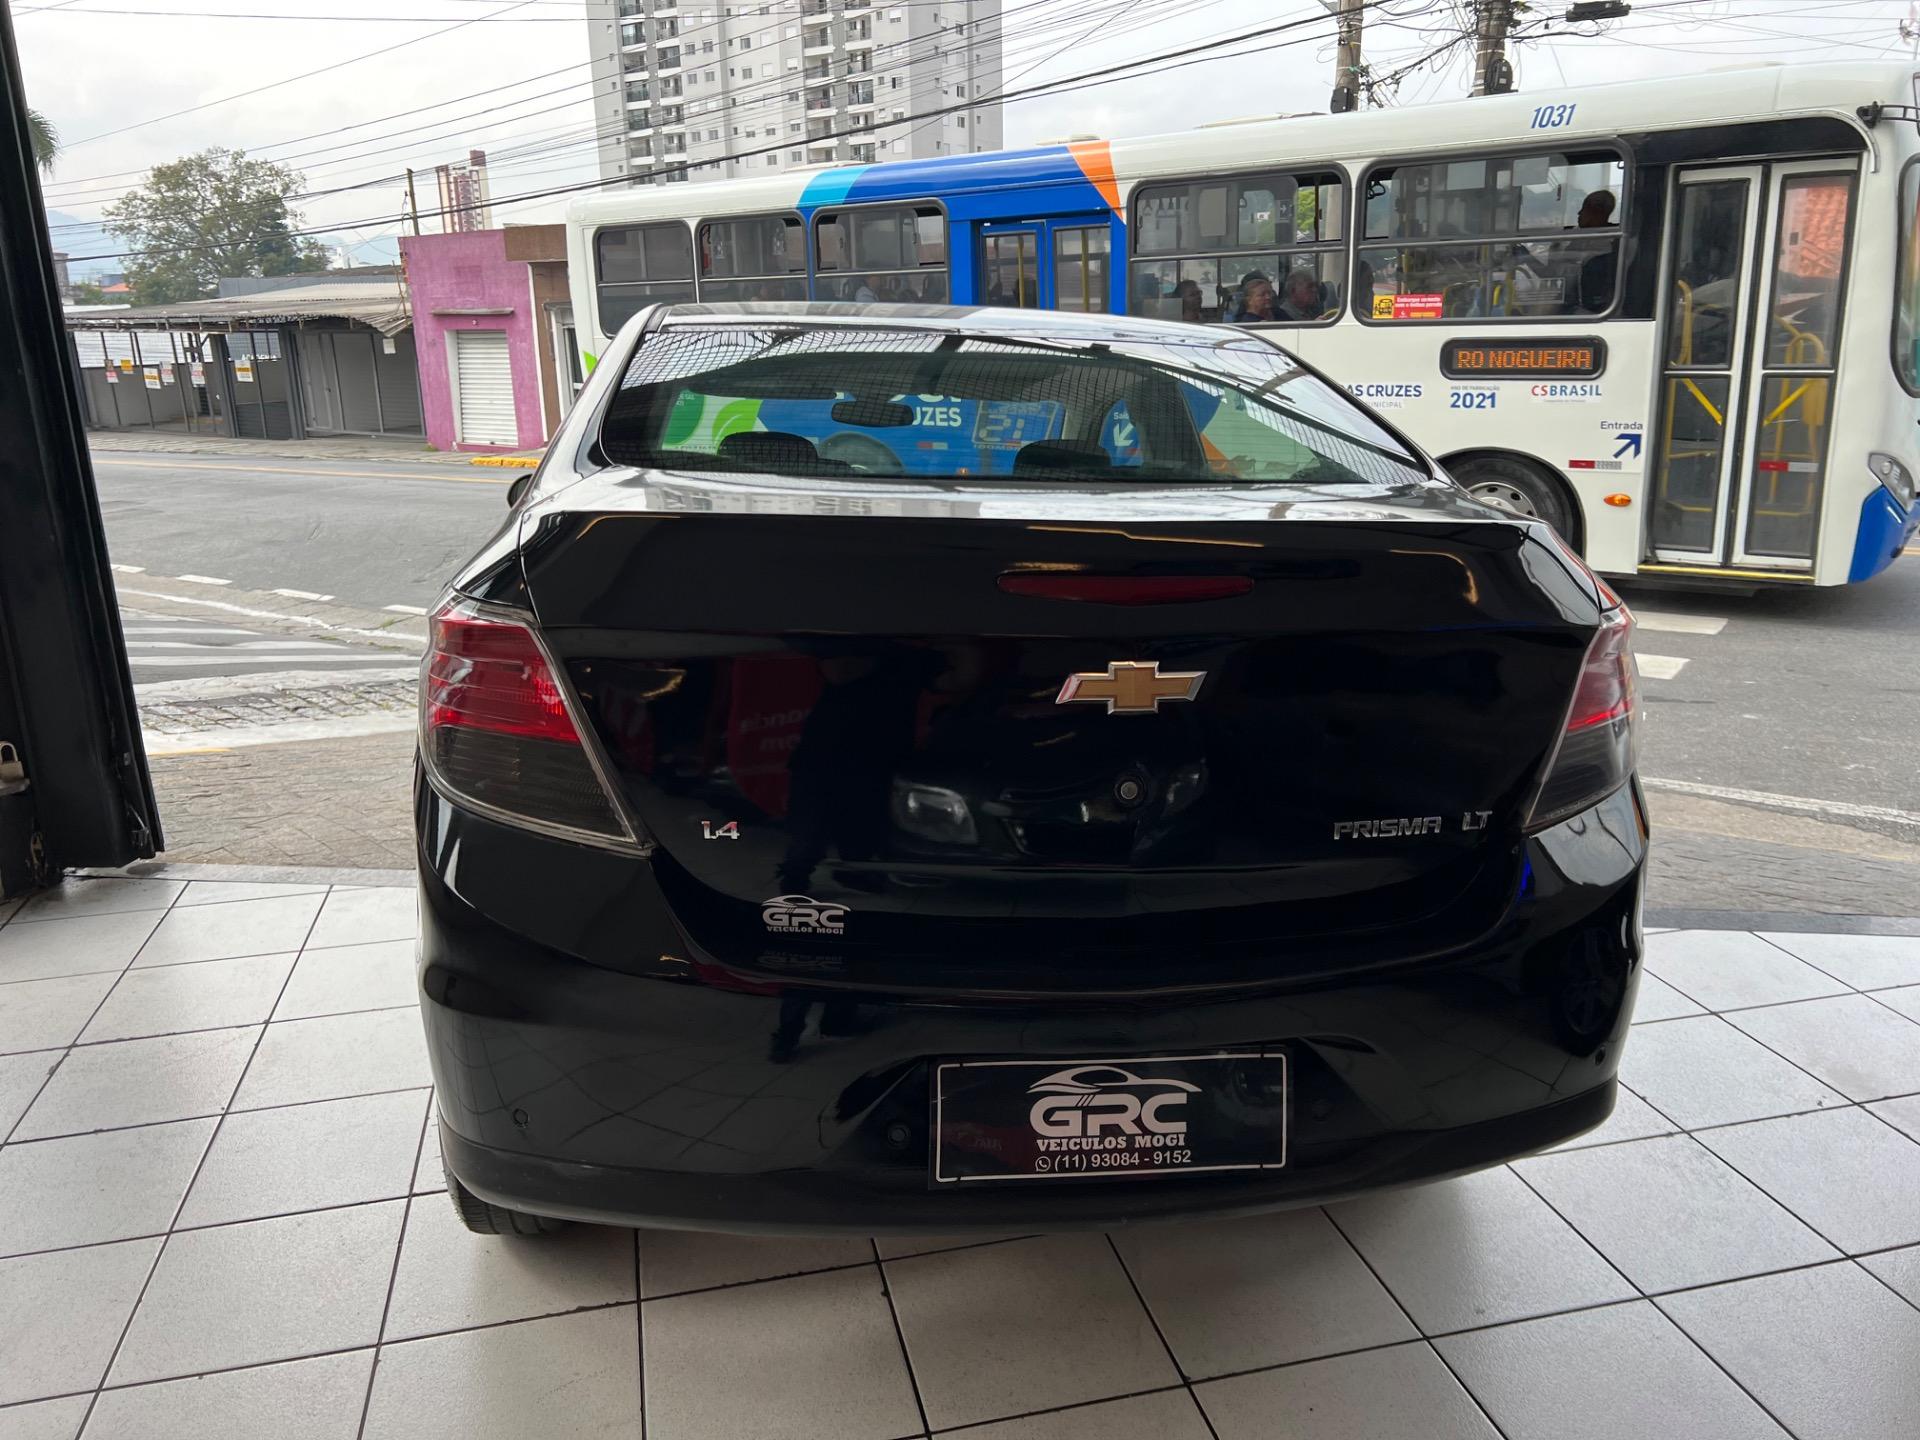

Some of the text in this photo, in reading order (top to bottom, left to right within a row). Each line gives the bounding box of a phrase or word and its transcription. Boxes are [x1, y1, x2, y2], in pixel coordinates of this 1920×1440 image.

[1530, 104, 1577, 129] 1031
[1457, 348, 1592, 368] RO NOGUEIRA
[1344, 384, 1422, 397] AS CRUZES
[1450, 391, 1497, 409] 2021
[1531, 384, 1602, 397] CSBRASIL
[1600, 420, 1644, 430] Entrada
[701, 820, 741, 840] 1.4
[1333, 810, 1493, 840] PRISMA LT
[762, 907, 845, 928] GRC
[816, 927, 845, 935] MOGI
[1029, 1092, 1188, 1138] GRC
[1036, 1133, 1185, 1152] VEICULOS MOGI
[1054, 1153, 1087, 1172] (11)
